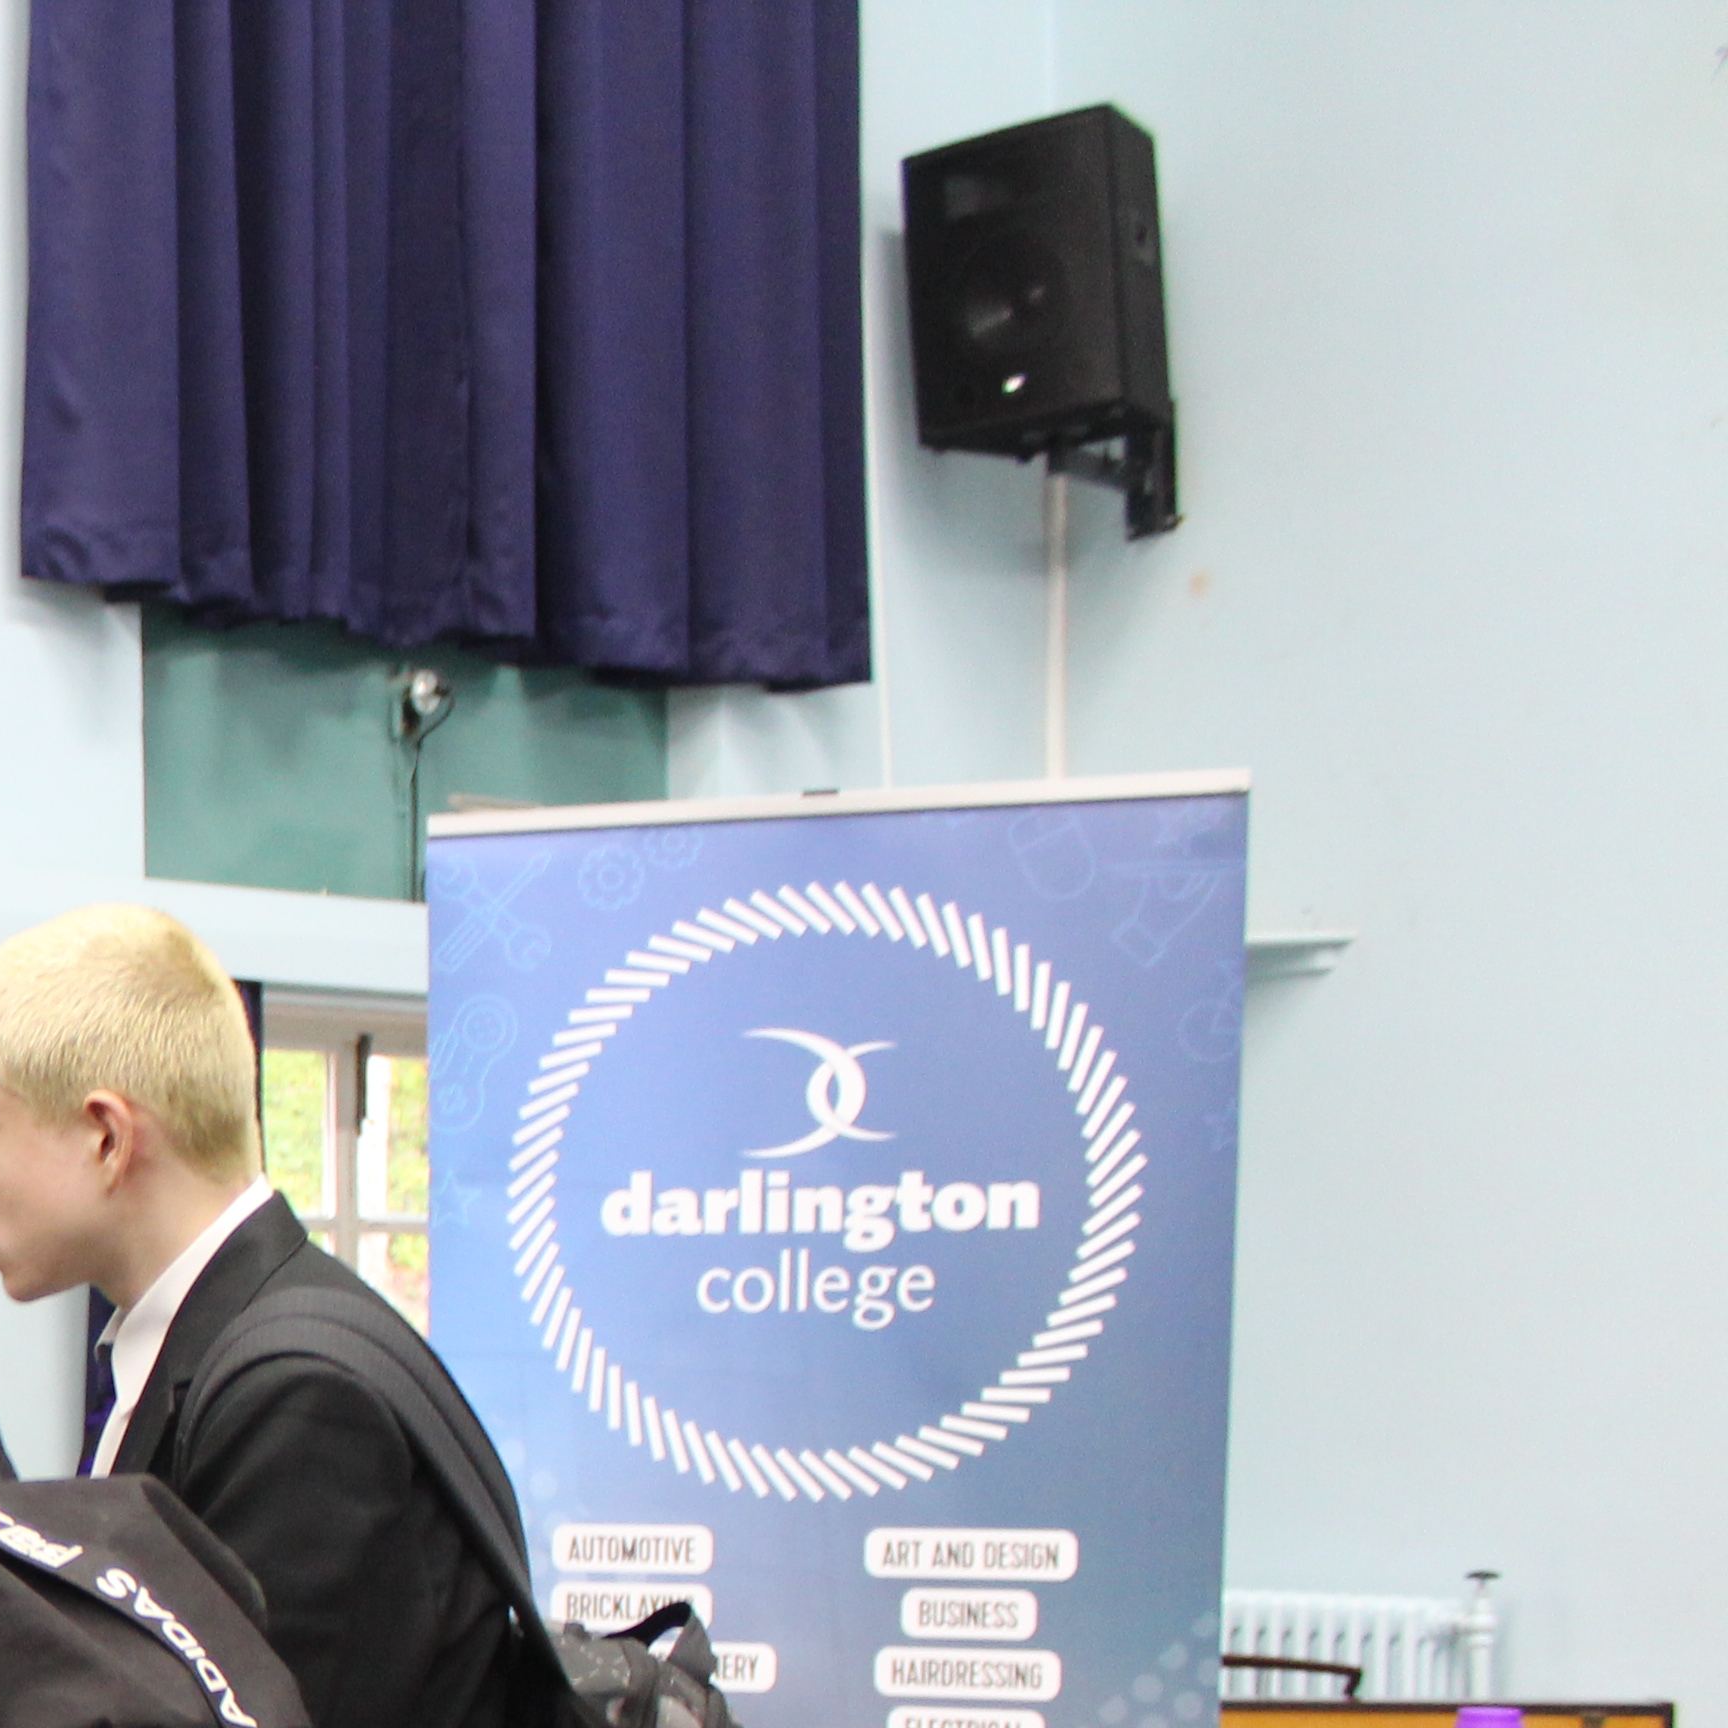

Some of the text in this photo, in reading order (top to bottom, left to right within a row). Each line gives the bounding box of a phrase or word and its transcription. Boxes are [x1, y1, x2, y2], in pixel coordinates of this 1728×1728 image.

[601, 1170, 1040, 1253] darlington
[697, 1250, 935, 1330] college
[568, 1536, 696, 1564] AUTOMOTIVE
[882, 1540, 1058, 1570] ART AND DESIGN
[918, 1600, 1019, 1629] BUSINESS
[96, 1567, 258, 1728] ADIDAS
[892, 1659, 1043, 1690] HAIRDRESSING
